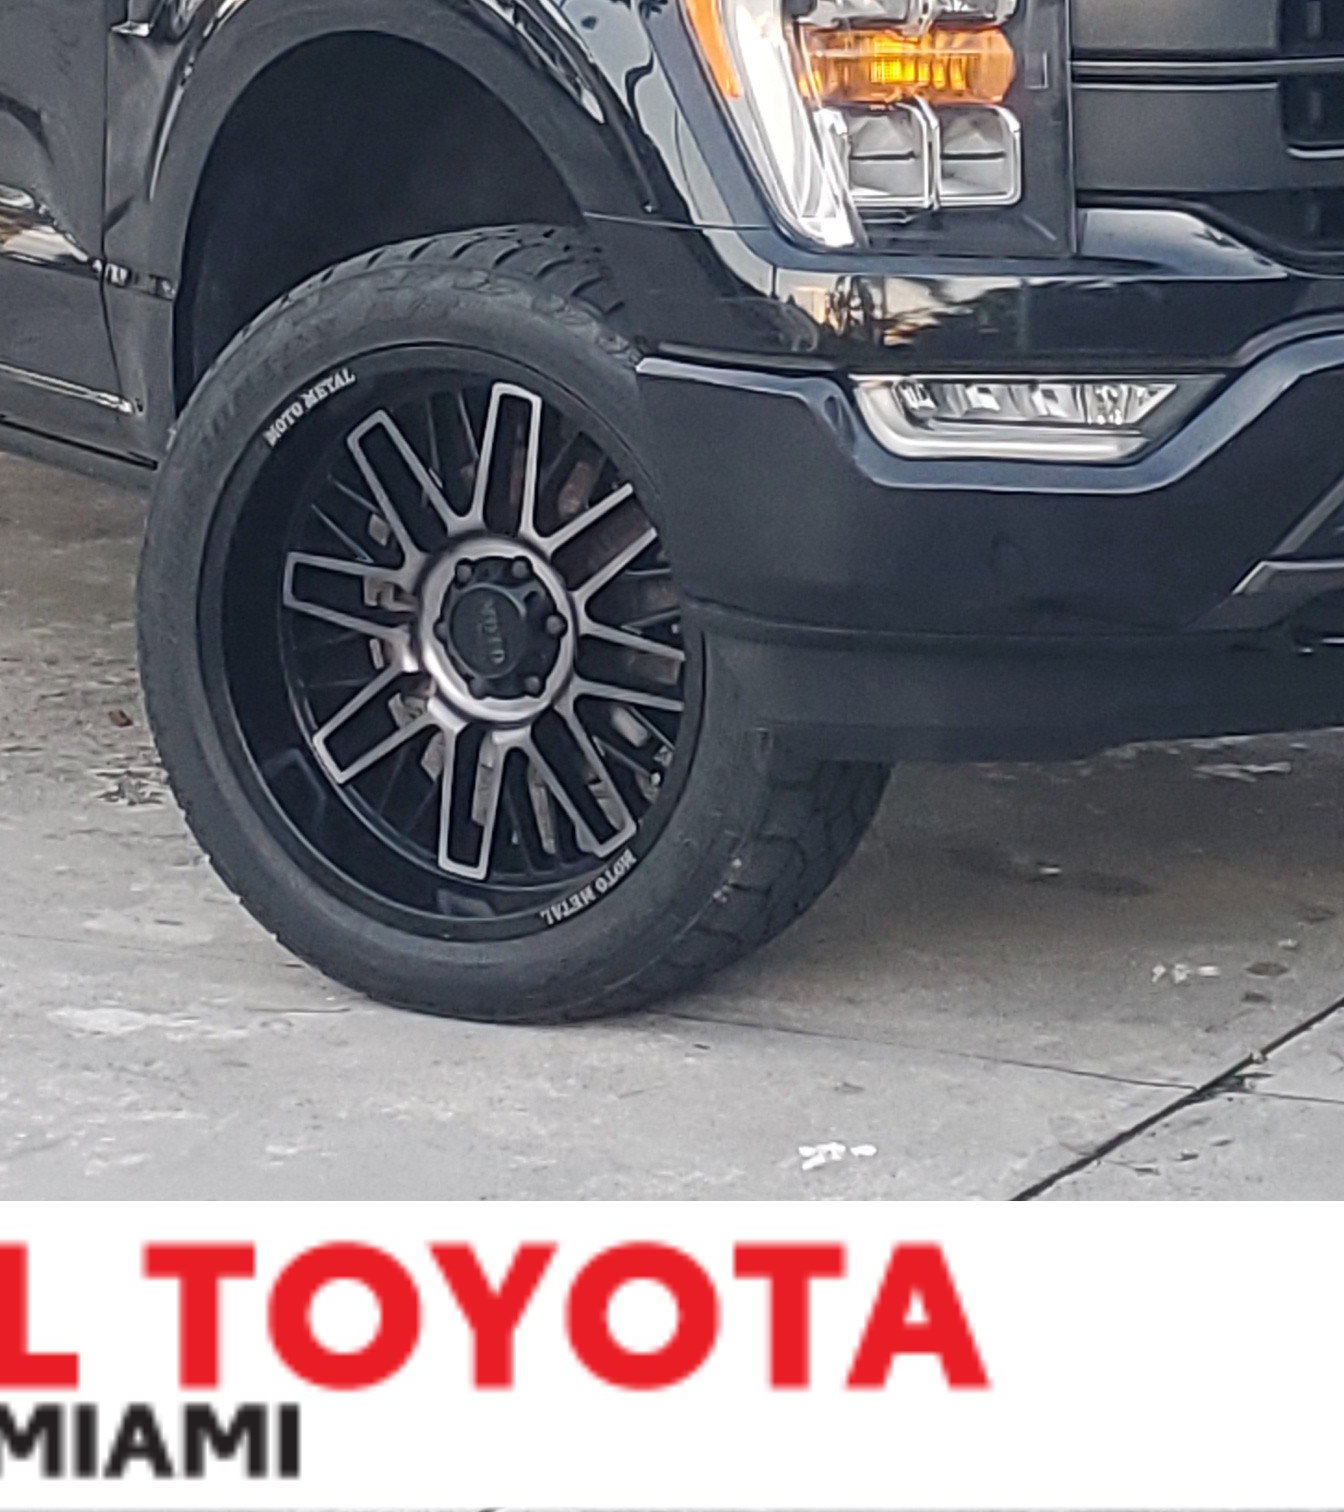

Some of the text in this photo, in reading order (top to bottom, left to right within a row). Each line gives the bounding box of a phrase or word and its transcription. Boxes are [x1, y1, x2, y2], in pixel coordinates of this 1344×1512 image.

[262, 367, 357, 448] MOTO METAL
[539, 847, 638, 926] MOTO METAL
